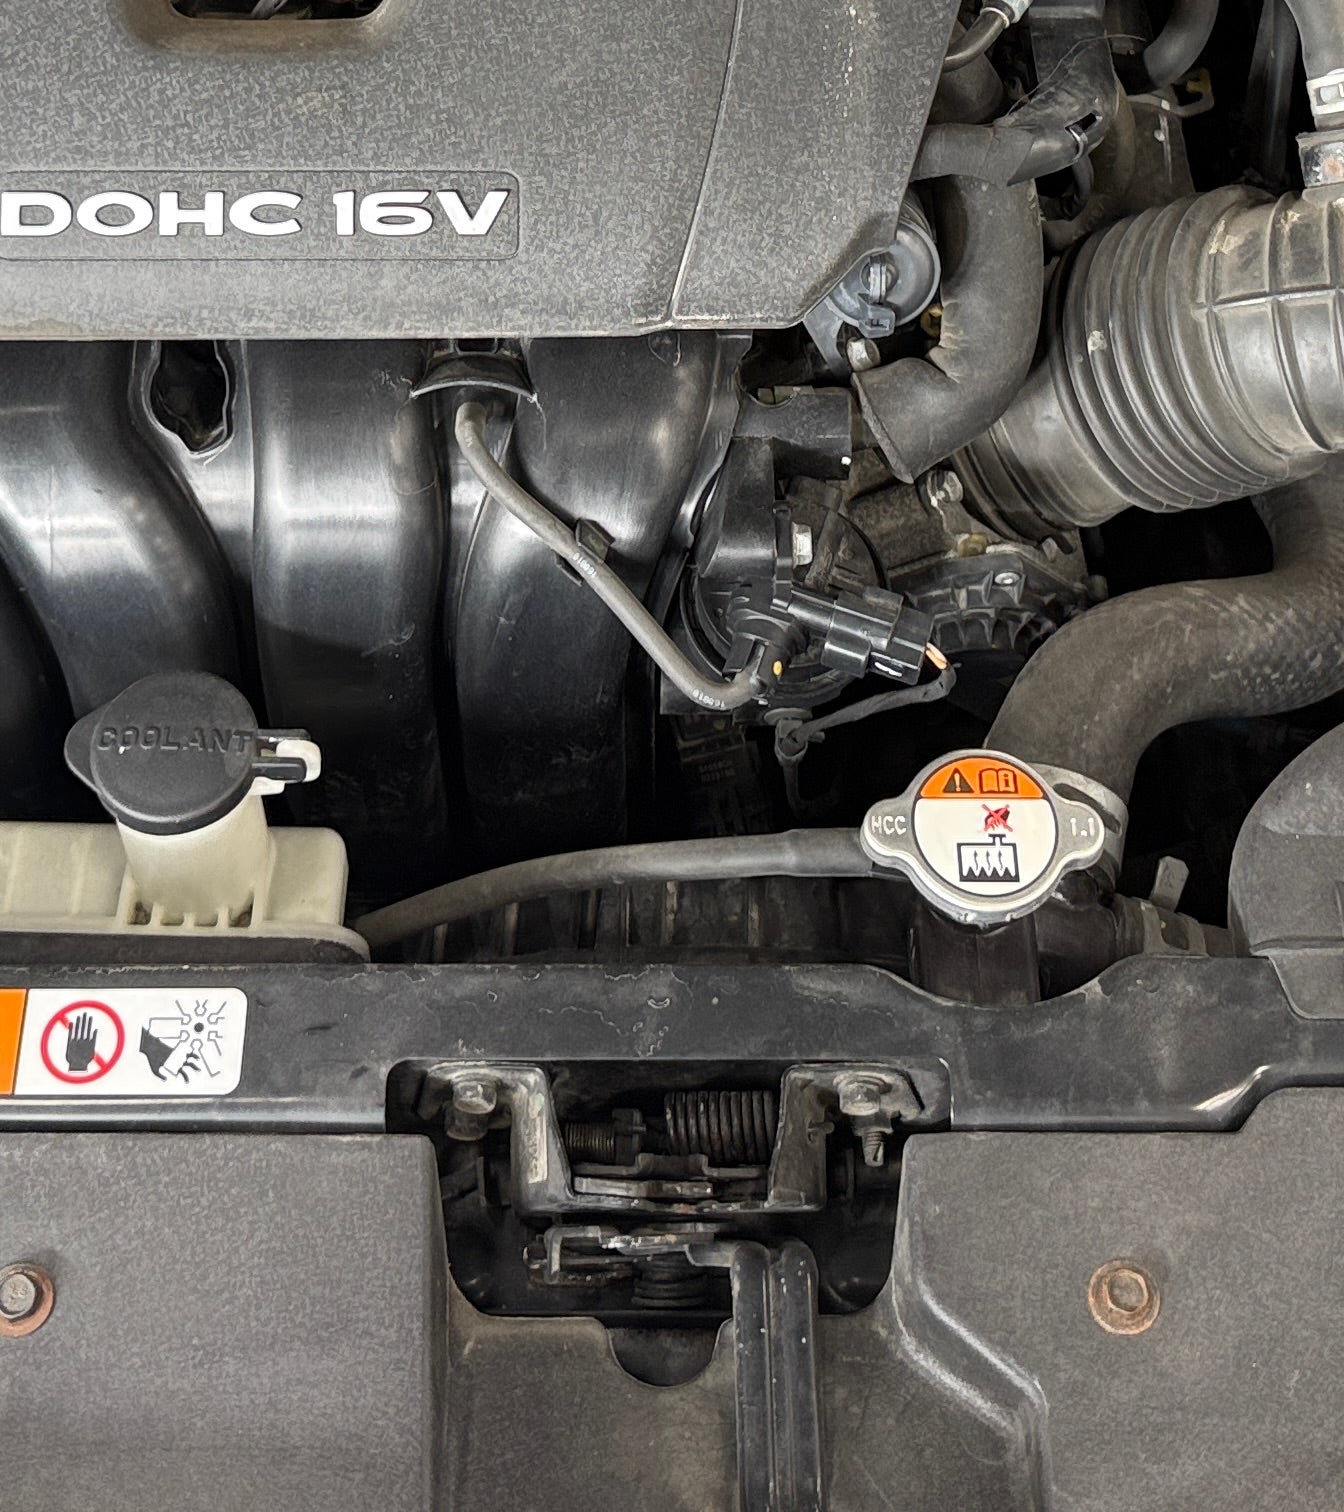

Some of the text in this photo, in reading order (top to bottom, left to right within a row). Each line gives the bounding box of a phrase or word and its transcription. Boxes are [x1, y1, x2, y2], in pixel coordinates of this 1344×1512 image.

[0, 188, 511, 237] DOHC 16V
[97, 725, 255, 755] COOLANT
[870, 815, 908, 837] HCC
[1069, 816, 1097, 838] 1.1
